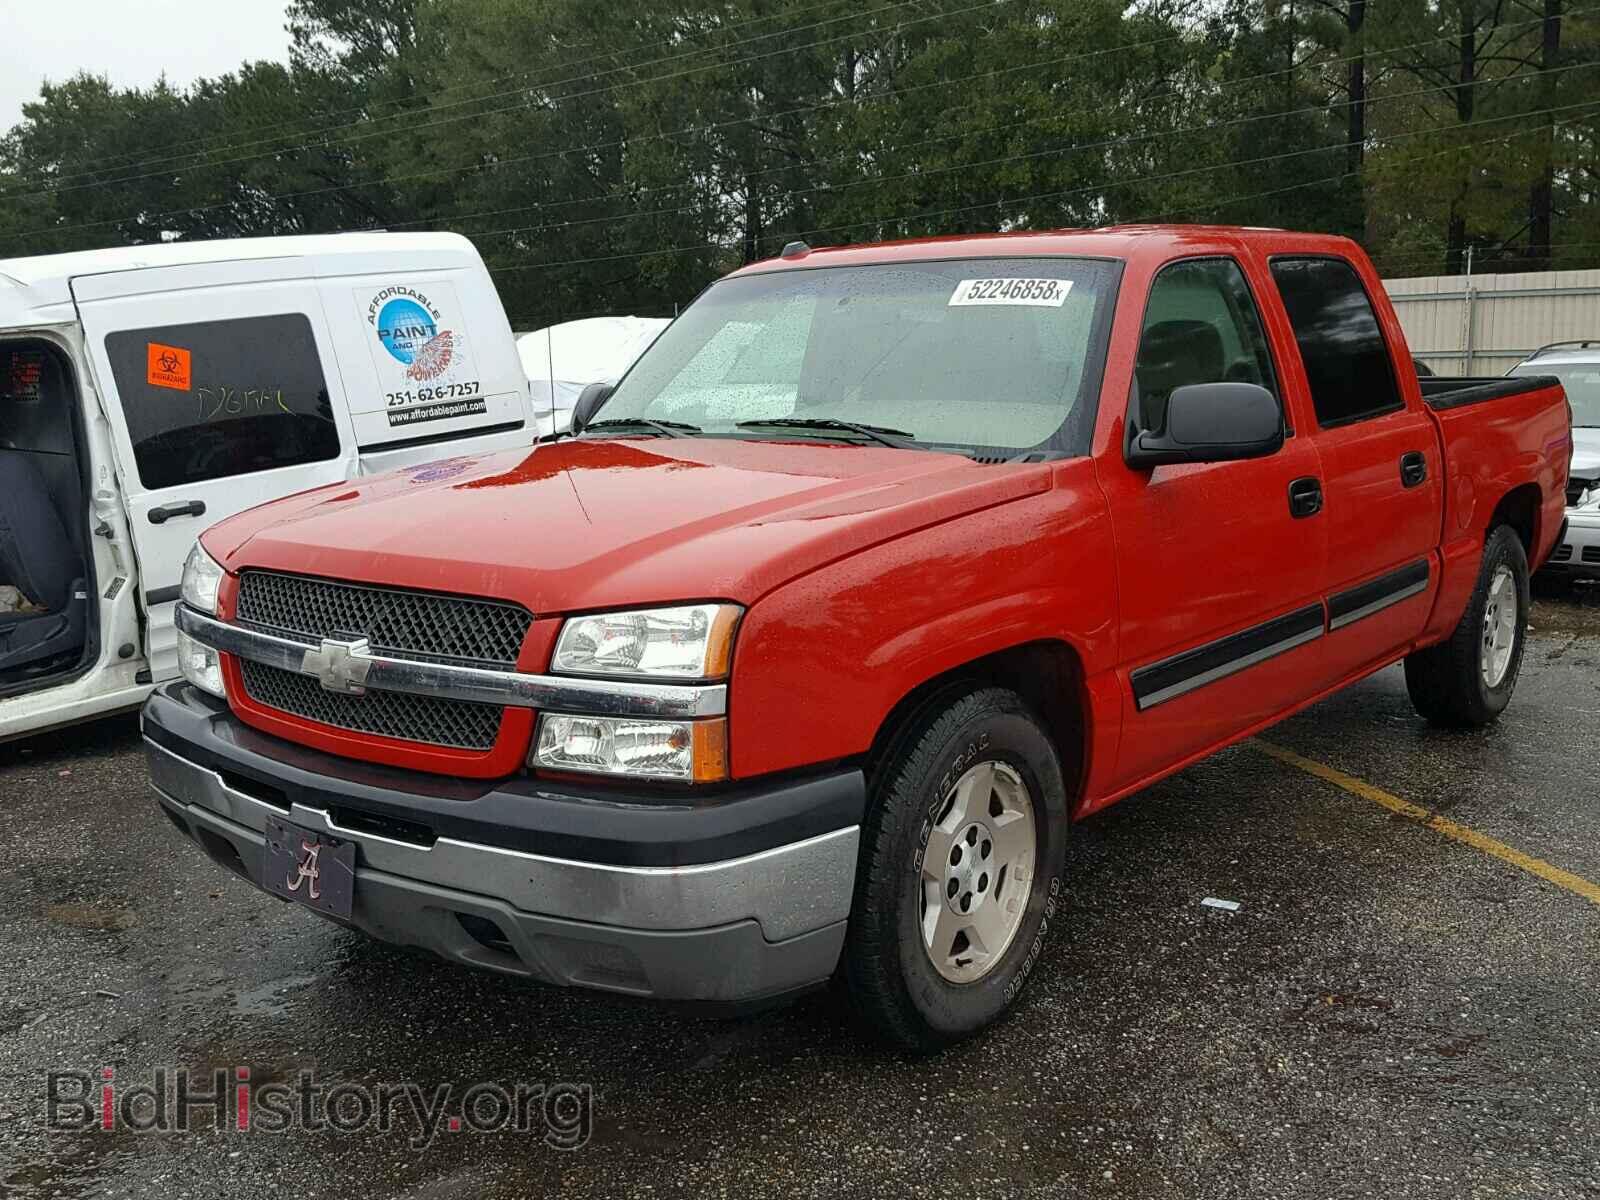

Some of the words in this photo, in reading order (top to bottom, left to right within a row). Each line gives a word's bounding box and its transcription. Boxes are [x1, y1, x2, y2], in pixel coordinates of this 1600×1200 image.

[367, 286, 440, 325] AFFORDABLE
[377, 324, 437, 341] PAINT
[392, 341, 413, 351] AND
[386, 382, 480, 406] 251-626-7257
[389, 402, 486, 423] www.affordablepaint.com
